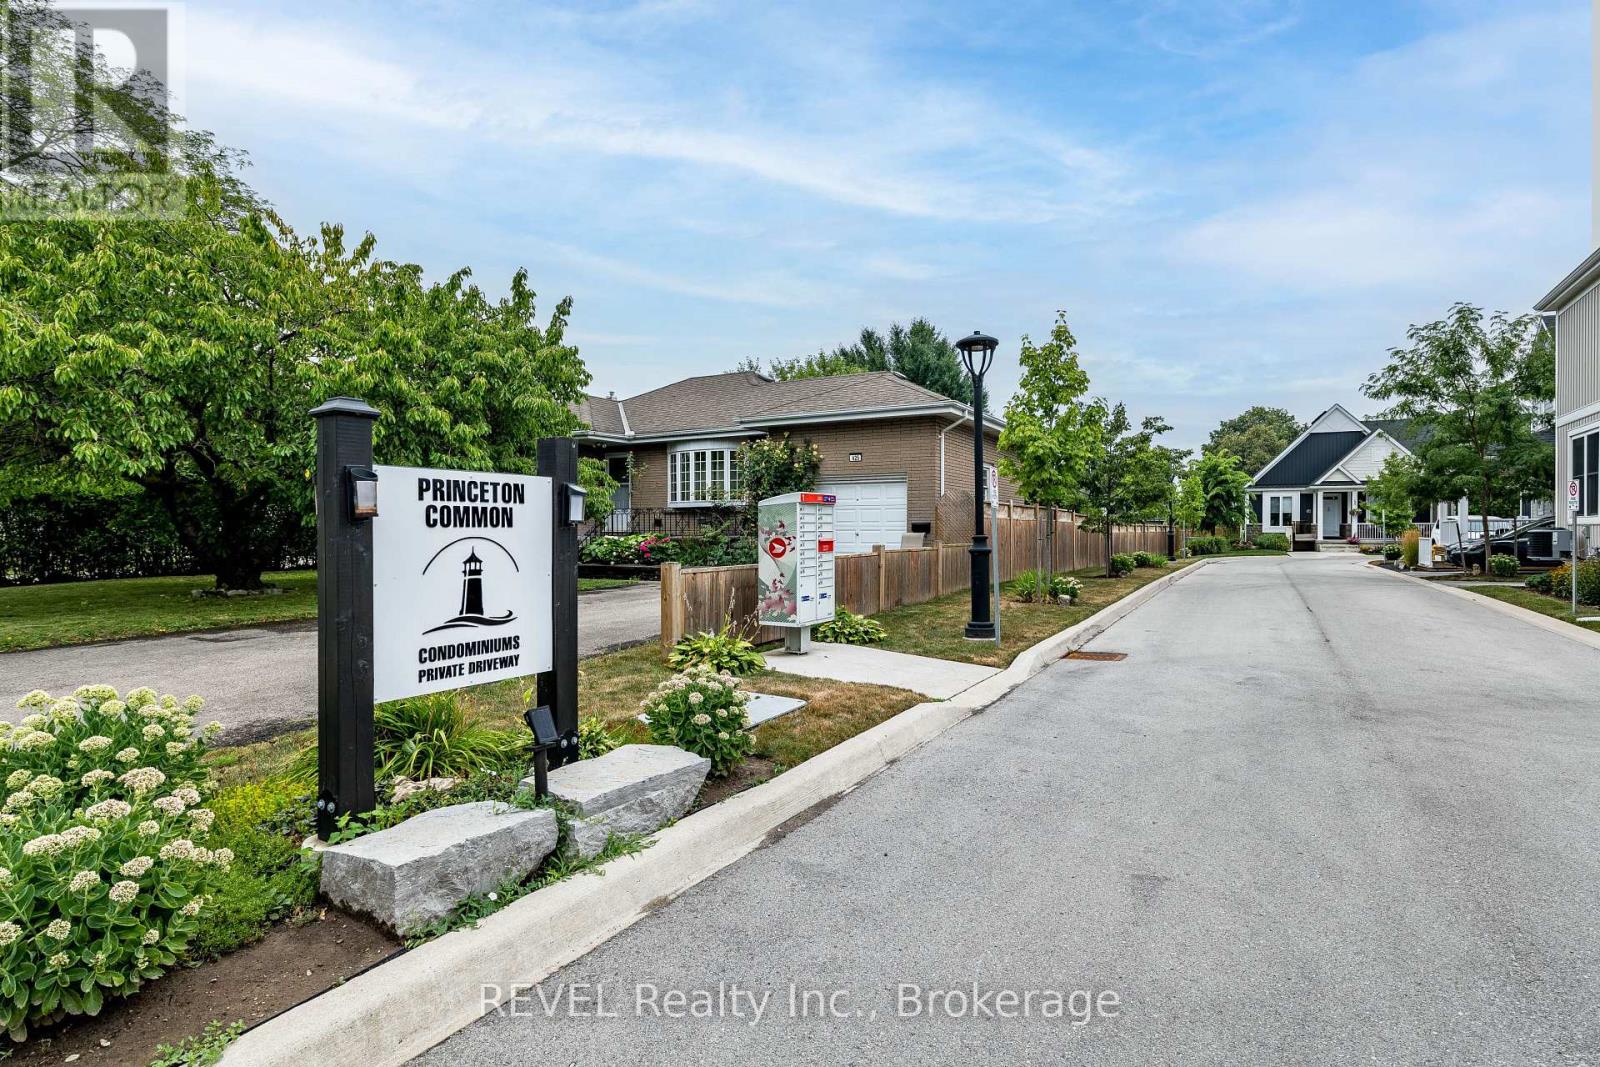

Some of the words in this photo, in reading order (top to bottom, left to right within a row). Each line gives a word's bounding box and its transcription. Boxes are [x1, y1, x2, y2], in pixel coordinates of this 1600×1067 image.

[418, 478, 525, 504] PRINCETON
[425, 505, 514, 528] COMMON
[418, 635, 520, 664] CONDOMINIUMS
[418, 663, 465, 683] PRIVATE
[468, 654, 520, 674] DRIVEWAY
